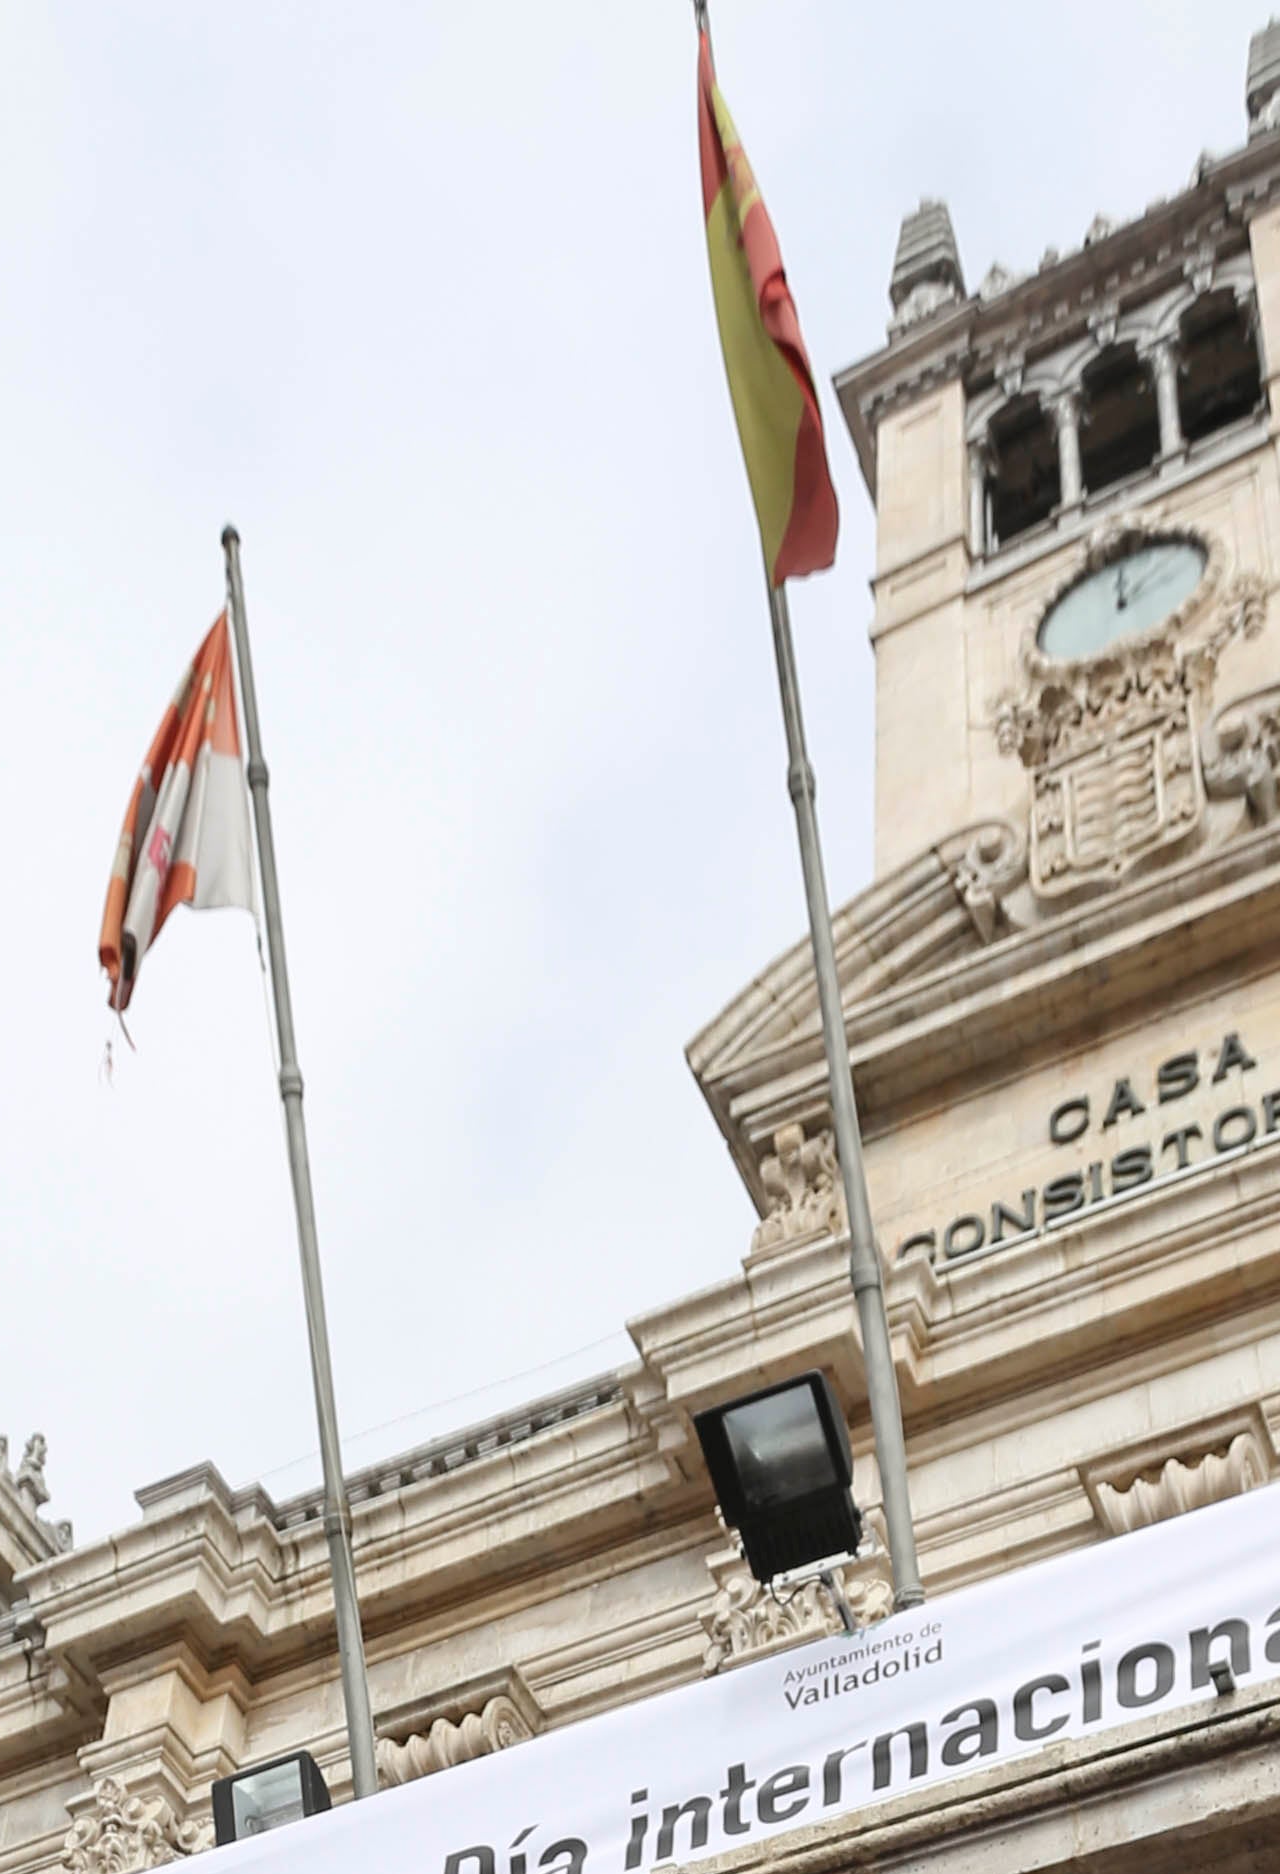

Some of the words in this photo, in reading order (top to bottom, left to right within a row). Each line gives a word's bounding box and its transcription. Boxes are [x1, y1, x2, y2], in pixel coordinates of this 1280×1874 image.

[1049, 1031, 1258, 1145] CASA
[783, 1632, 914, 1686] Ayuntamiento
[919, 1621, 943, 1639] de
[784, 1638, 943, 1711] Valladolid
